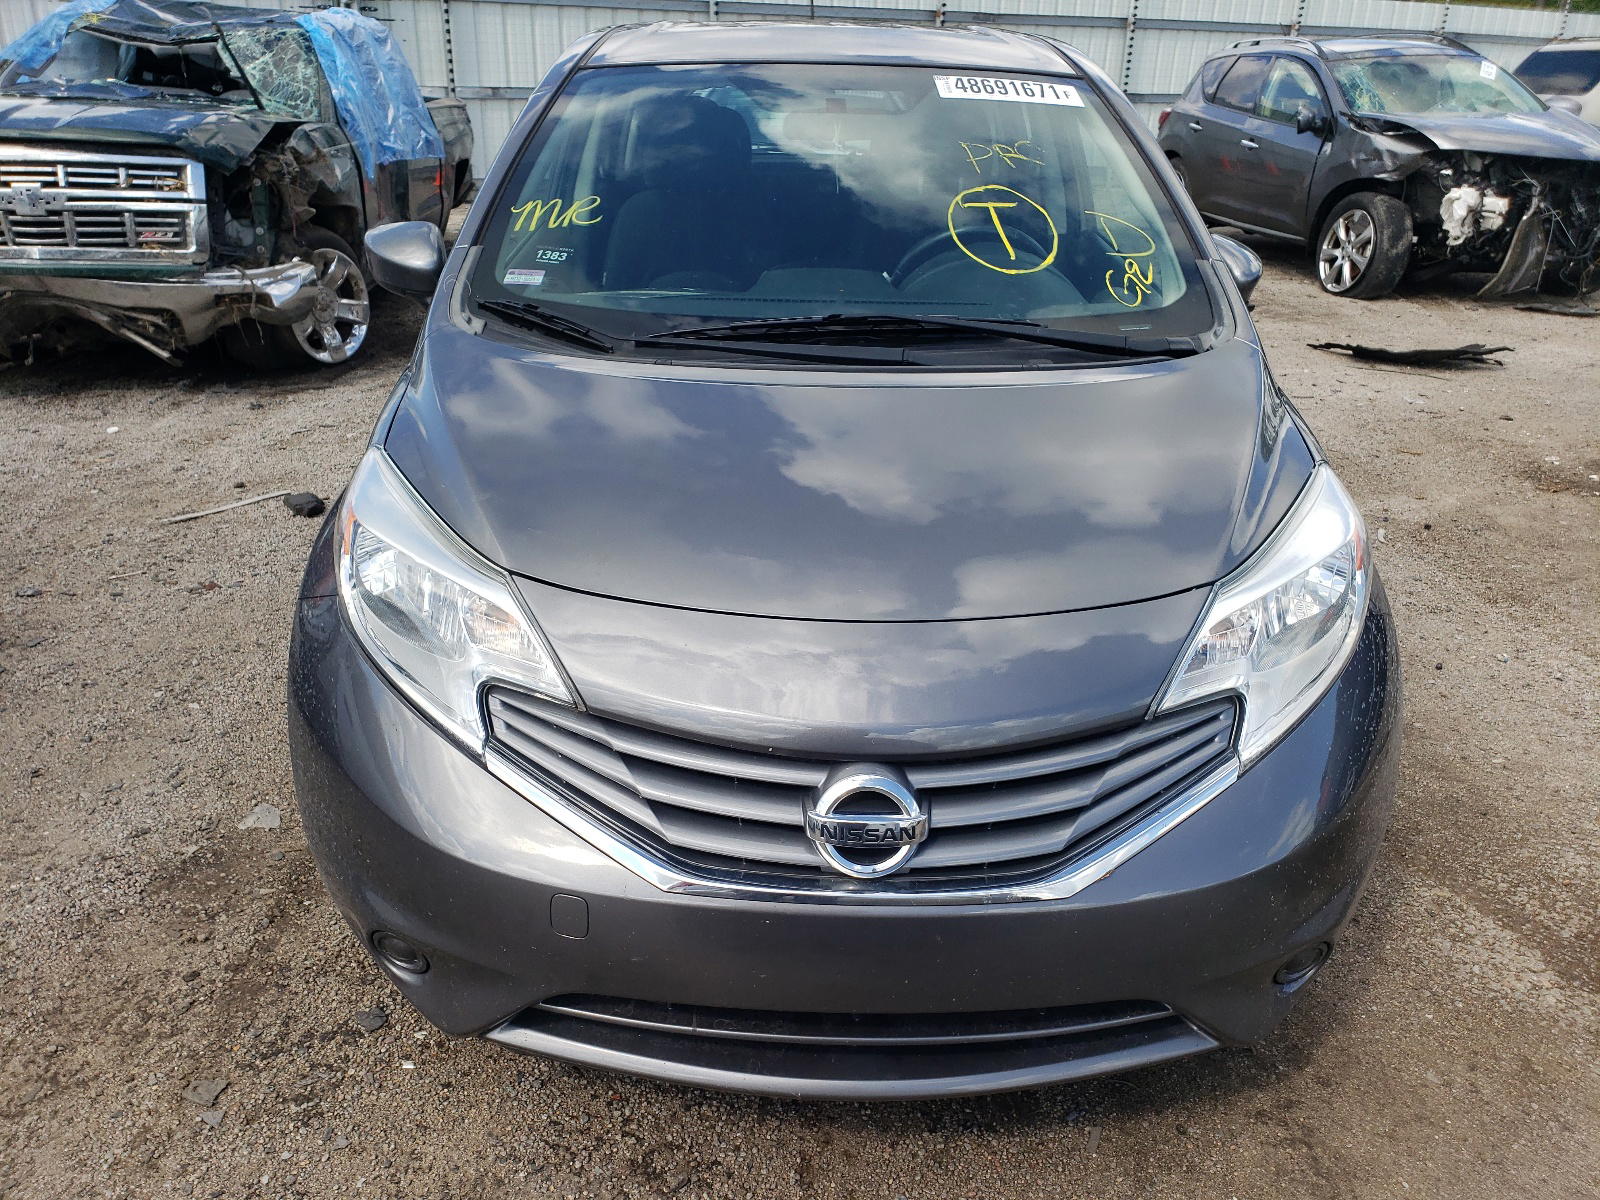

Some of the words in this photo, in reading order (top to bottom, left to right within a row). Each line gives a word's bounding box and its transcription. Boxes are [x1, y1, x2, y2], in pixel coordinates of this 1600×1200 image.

[955, 77, 1060, 100] 48691671
[962, 202, 1018, 260] T
[536, 249, 568, 261] 1383
[820, 823, 916, 843] NISSAN
